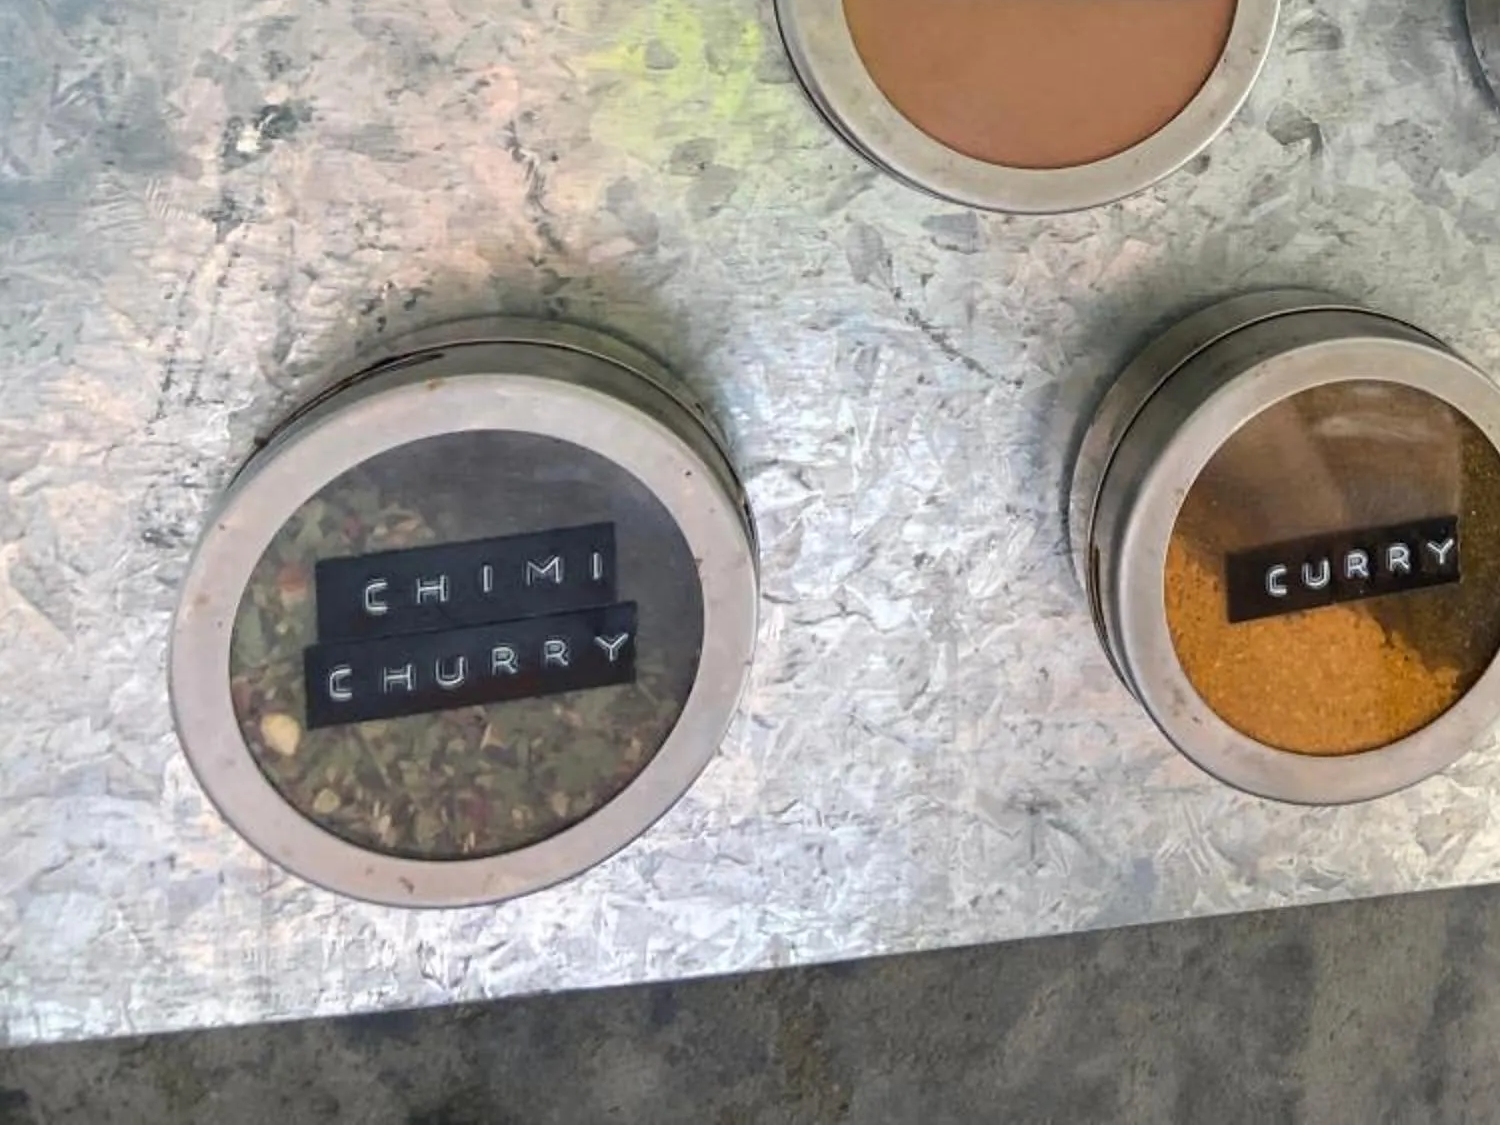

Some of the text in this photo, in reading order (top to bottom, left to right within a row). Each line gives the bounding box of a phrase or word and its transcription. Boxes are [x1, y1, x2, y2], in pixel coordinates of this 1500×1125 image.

[363, 551, 603, 616] CHIMI
[1265, 538, 1454, 597] CURRY
[328, 632, 629, 702] CHURRY
